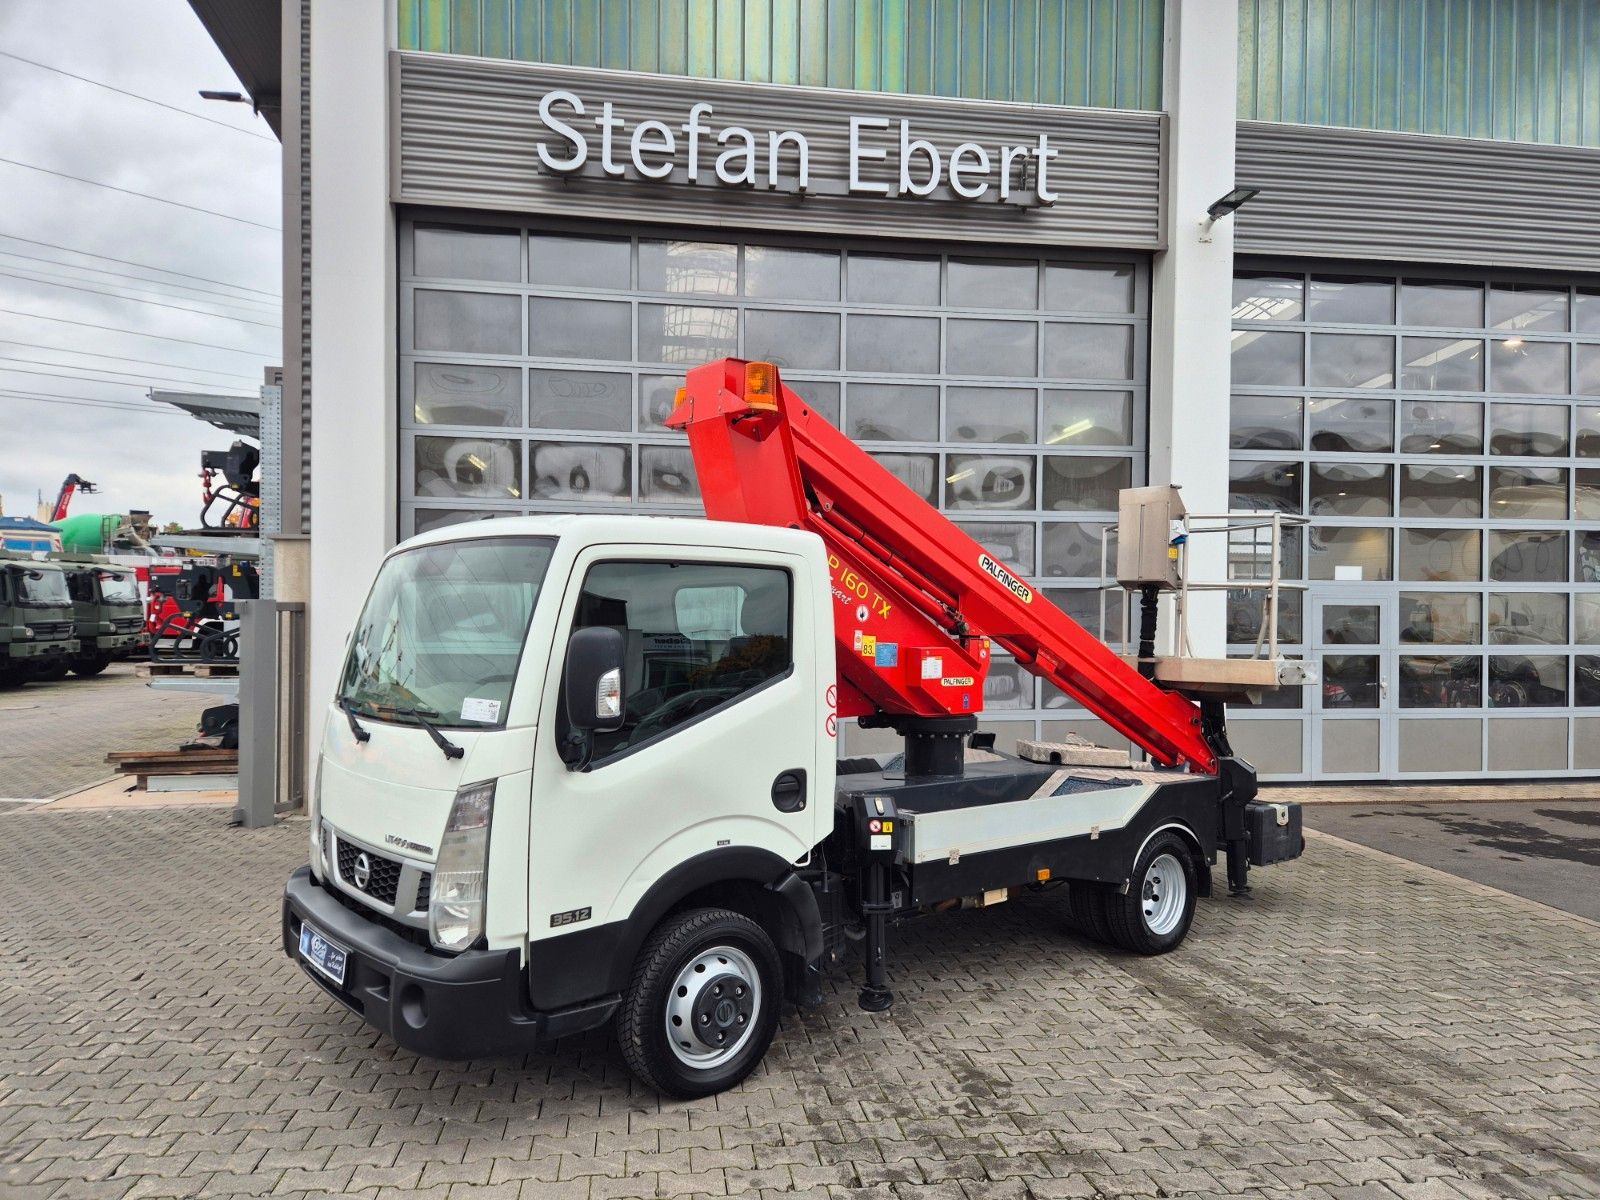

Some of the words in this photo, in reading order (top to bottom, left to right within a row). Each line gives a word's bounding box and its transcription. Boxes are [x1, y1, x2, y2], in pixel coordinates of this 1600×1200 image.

[536, 90, 809, 193] Stefan
[848, 116, 1059, 203] Ebert
[840, 567, 869, 599] 160
[872, 592, 892, 620] TX
[981, 556, 1030, 601] PALFINGER
[943, 678, 972, 686] PALFINGER
[552, 908, 590, 927] 35.12
